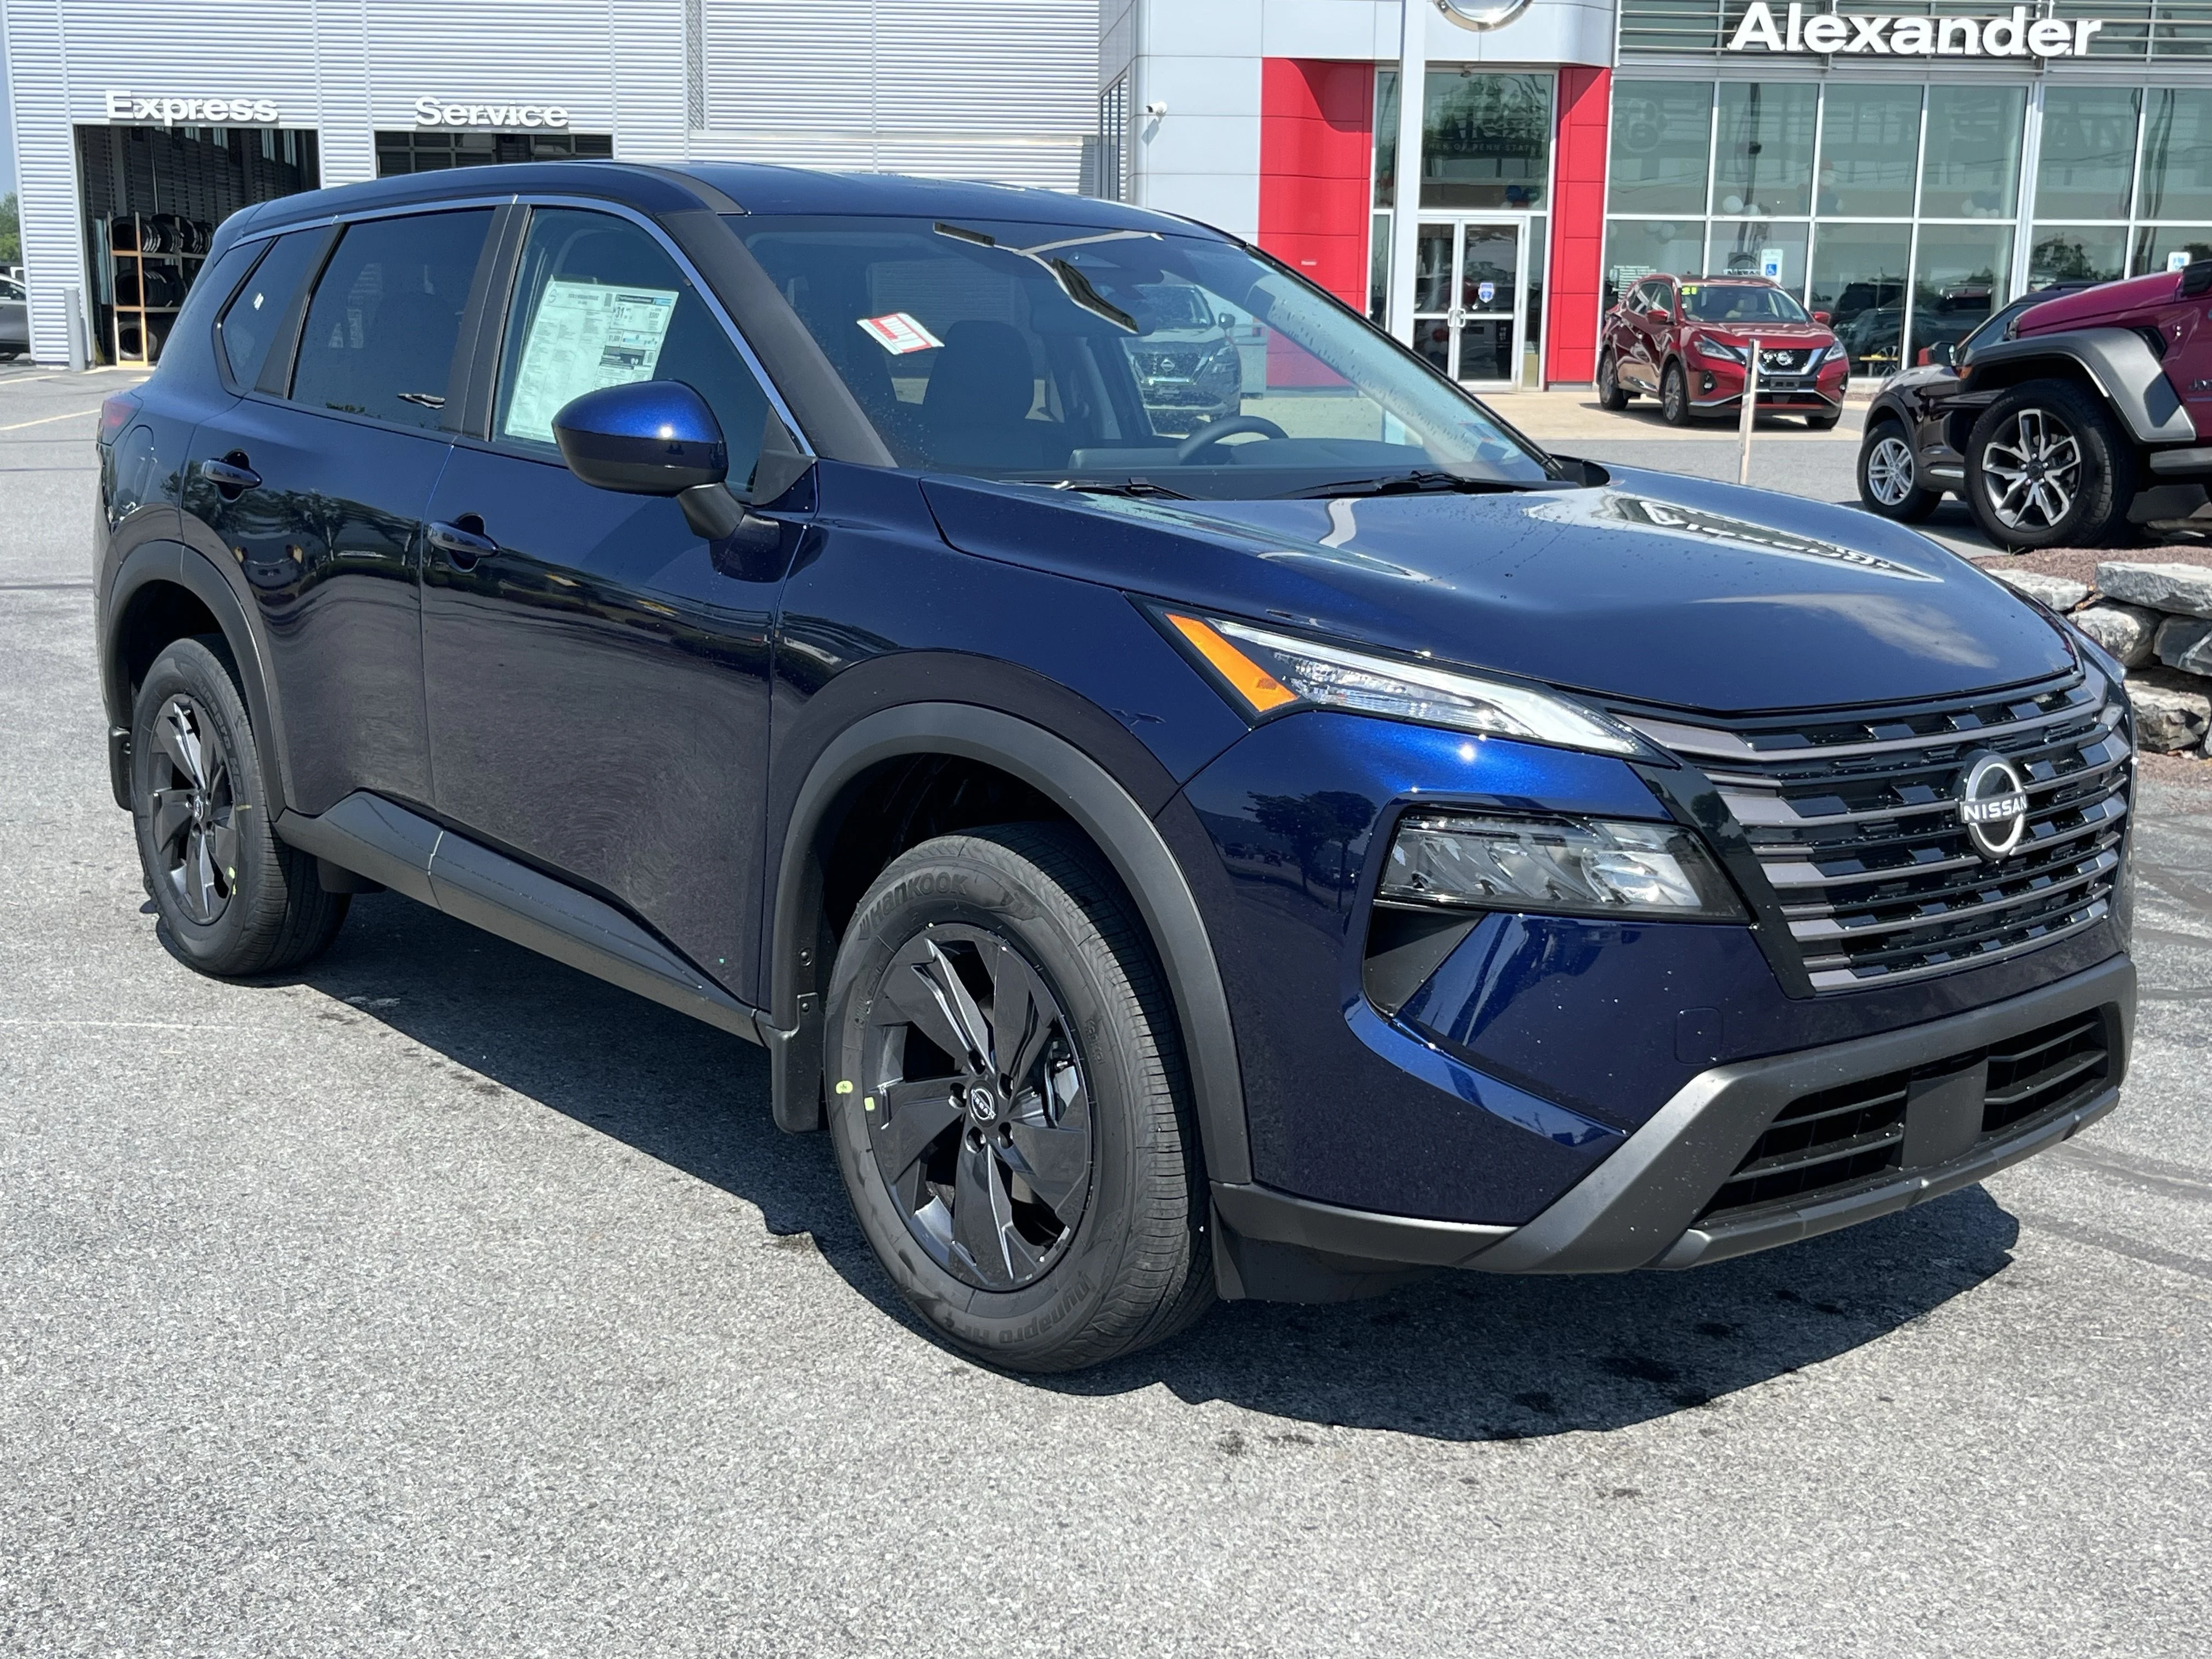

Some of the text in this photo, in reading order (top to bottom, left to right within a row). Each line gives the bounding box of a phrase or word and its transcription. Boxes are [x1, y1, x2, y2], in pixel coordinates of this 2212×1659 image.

[1727, 2, 2102, 57] Alexander
[105, 89, 278, 127] Express
[415, 96, 568, 127] Service
[1681, 286, 1697, 295] 21
[1963, 795, 2028, 820] NISSAN
